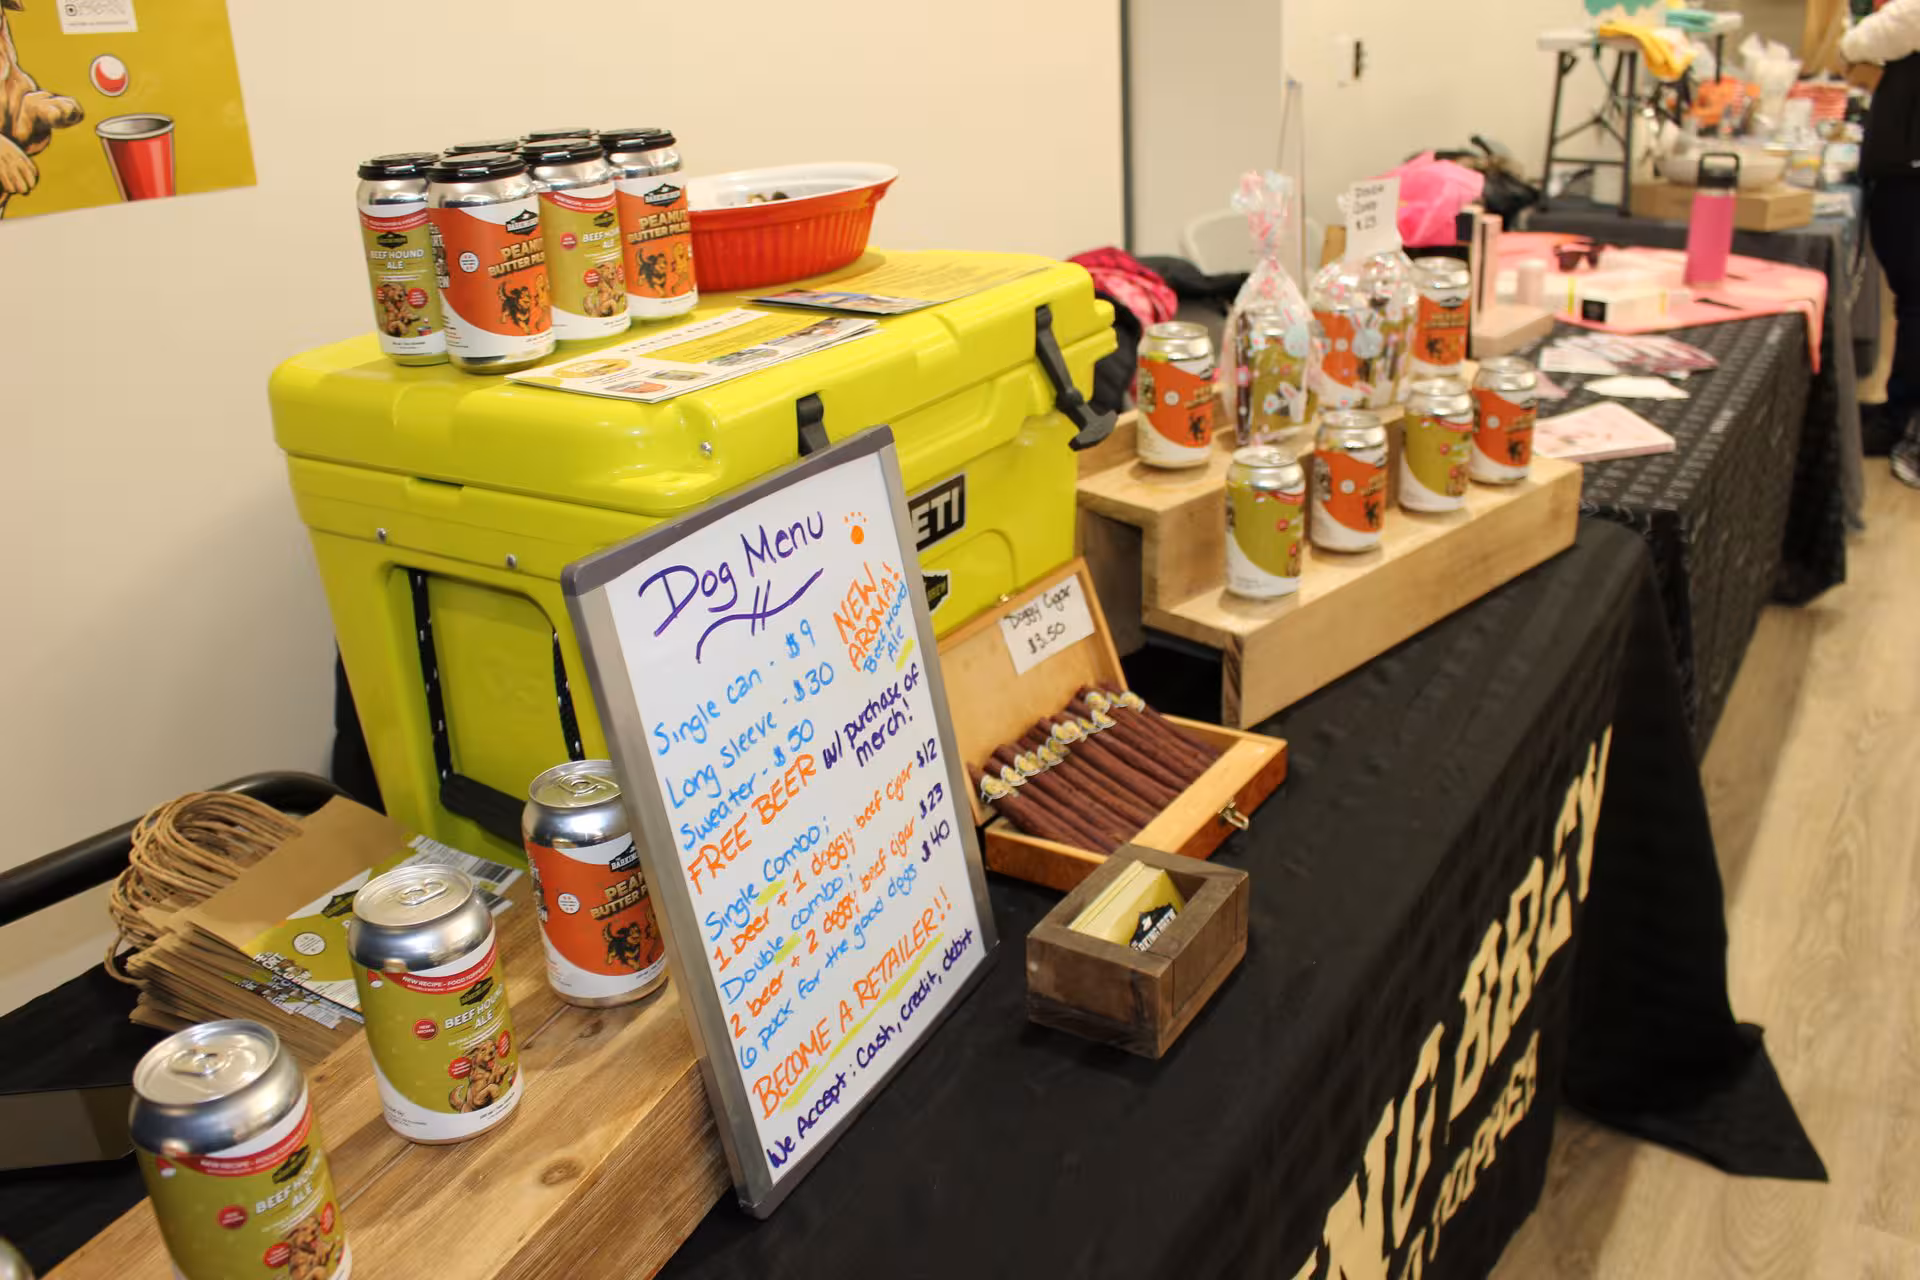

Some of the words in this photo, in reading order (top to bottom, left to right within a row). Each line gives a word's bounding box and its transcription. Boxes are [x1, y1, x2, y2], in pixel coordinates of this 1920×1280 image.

[627, 226, 669, 244] BUTTER
[639, 209, 687, 230] PEANUT
[370, 250, 388, 260] BEEF
[389, 249, 424, 259] HOUND
[387, 261, 404, 269] ALE
[488, 256, 530, 276] BUTTER
[638, 562, 739, 637] Dog
[740, 511, 825, 578] Menu
[833, 561, 877, 645] NEW
[1003, 602, 1043, 629] Doggy
[1043, 584, 1071, 612] Cigar
[1027, 621, 1066, 654] $3.50
[653, 703, 721, 757] Single
[726, 669, 763, 705] can
[665, 764, 722, 810] Long
[792, 661, 834, 702] $30
[855, 696, 914, 769] merch!
[687, 812, 753, 896] FREE
[751, 753, 817, 826] BEER
[822, 729, 843, 770] w/
[843, 682, 902, 750] purchase
[904, 662, 919, 692] of
[714, 946, 732, 973] 1
[731, 906, 769, 956] beer
[793, 869, 807, 894] 1
[856, 790, 882, 830] beef
[916, 737, 938, 768] $12
[591, 890, 640, 919] BUTTER
[705, 883, 760, 943] Single
[730, 1013, 747, 1040] 2
[746, 970, 784, 1018] beer
[806, 928, 819, 955] 2
[919, 782, 943, 819] $23
[1447, 724, 1613, 1125] BREW
[720, 936, 784, 1005] Double
[739, 1045, 758, 1070] 6
[757, 997, 795, 1052] pack
[798, 969, 821, 1000] for
[825, 938, 849, 969] the
[854, 896, 884, 950] good
[888, 863, 917, 898] dogs
[921, 819, 950, 863] $40
[402, 976, 419, 985] NEW
[418, 979, 443, 987] RECIPE
[447, 976, 466, 987] FOOD
[752, 1017, 832, 1121] BECOME
[839, 999, 854, 1034] A
[853, 885, 953, 1009] RETAILER!!
[444, 1008, 476, 1029] BEEF
[474, 1009, 494, 1029] ALE
[767, 1136, 796, 1169] We
[796, 1072, 848, 1140] Accept
[942, 928, 973, 971] debit
[255, 1184, 293, 1215] BEEF
[291, 1180, 313, 1209] ALE
